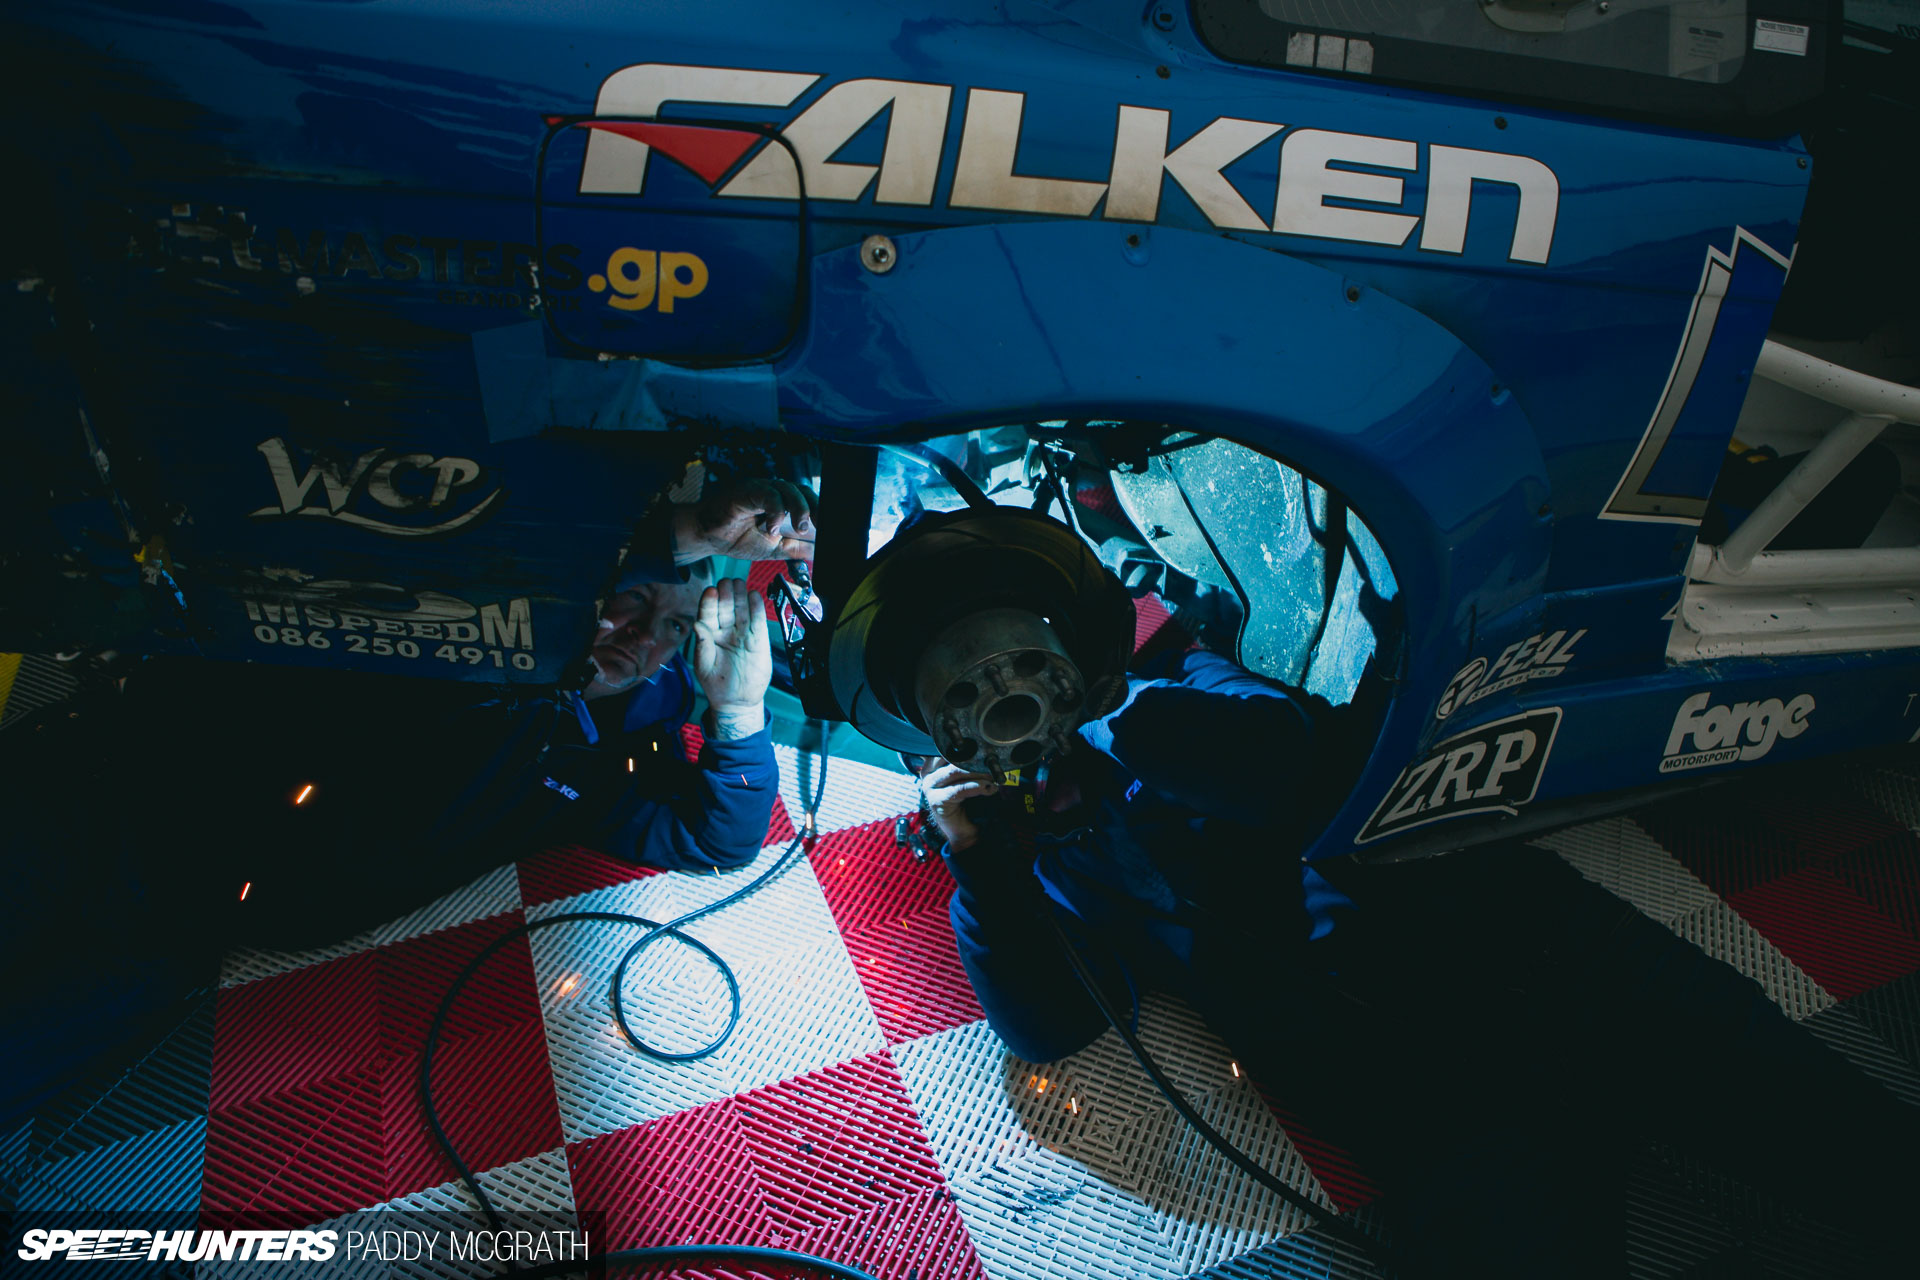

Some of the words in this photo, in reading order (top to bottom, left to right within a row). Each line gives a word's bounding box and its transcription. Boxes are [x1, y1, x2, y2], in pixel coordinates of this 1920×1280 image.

[579, 62, 1560, 265] FALKEN
[257, 436, 480, 515] WCP
[253, 624, 332, 650] 086
[344, 634, 421, 659] 250
[434, 644, 536, 671] 4910
[1478, 628, 1589, 688] FEAL
[1377, 728, 1537, 828] ZRP
[1663, 750, 1736, 770] MOTORSPORT
